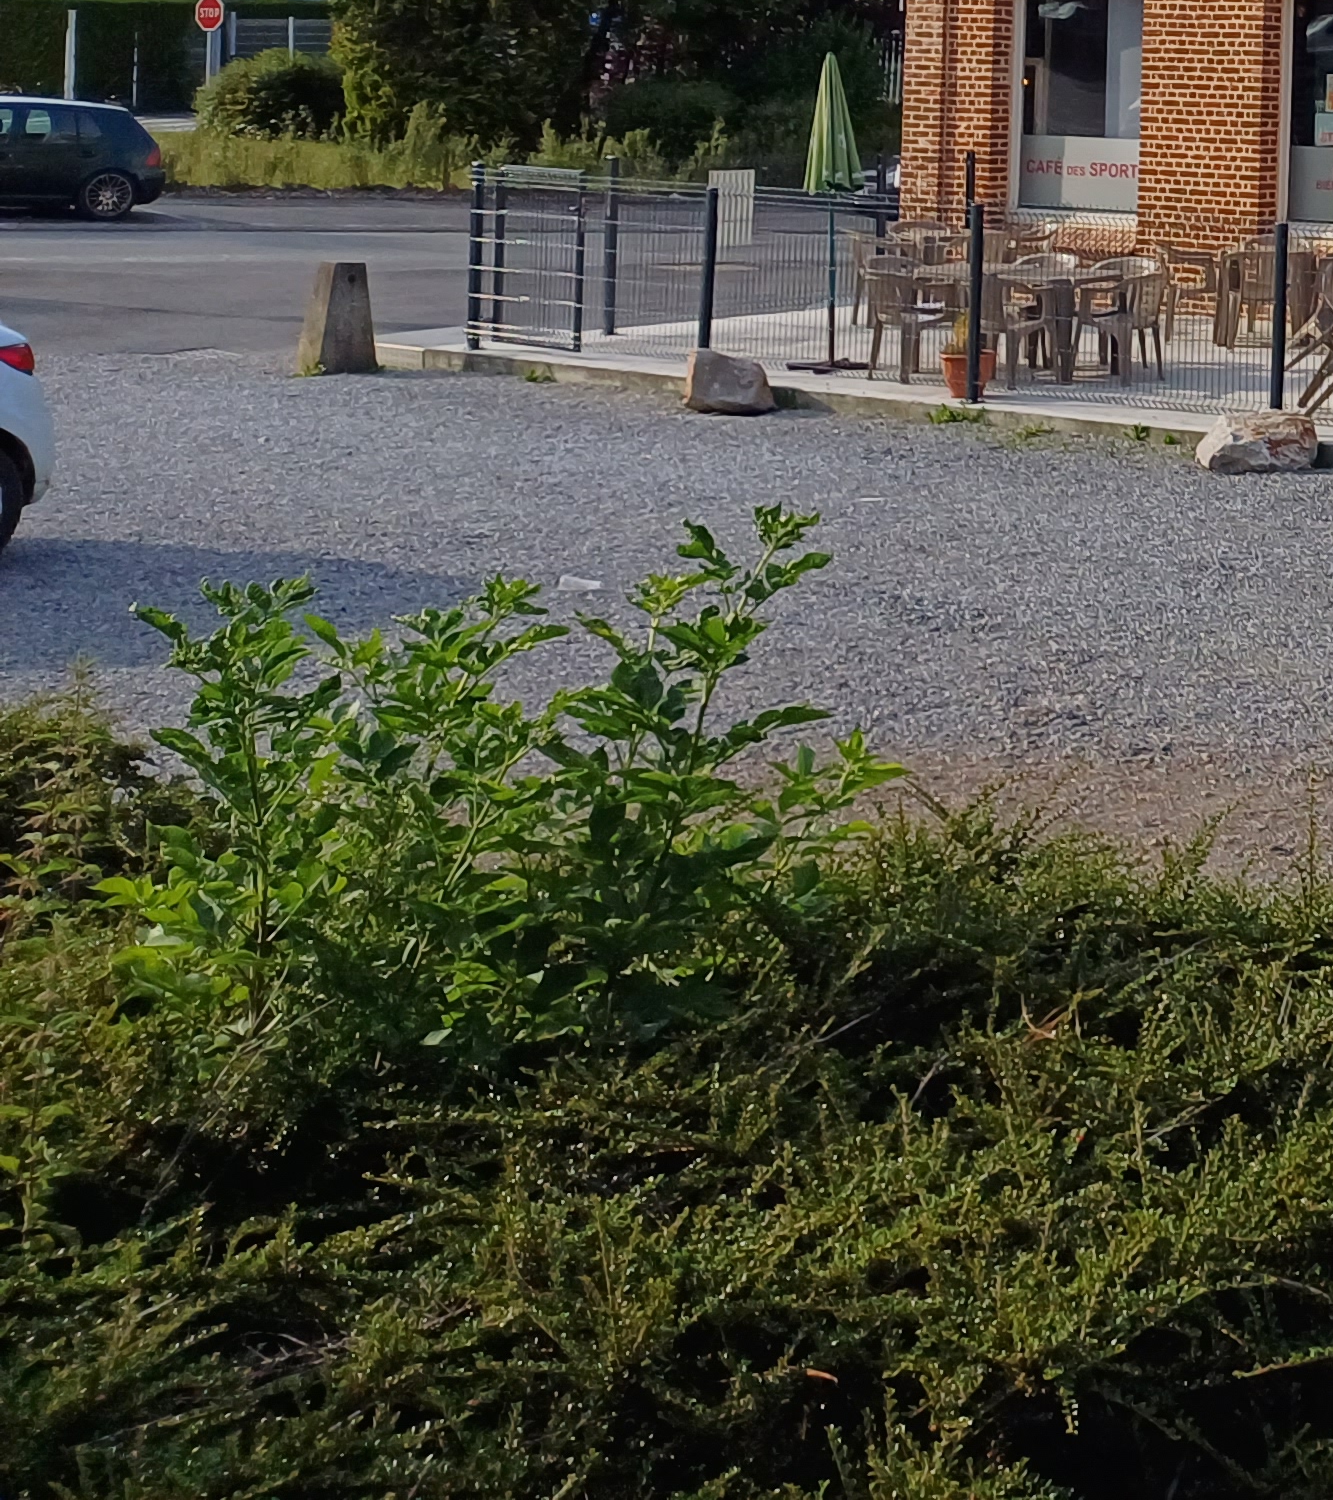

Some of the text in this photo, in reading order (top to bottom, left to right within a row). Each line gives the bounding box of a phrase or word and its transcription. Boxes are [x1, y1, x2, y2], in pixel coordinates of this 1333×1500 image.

[199, 7, 220, 18] STOP
[1027, 157, 1139, 179] CAFÉ DES SPORT
